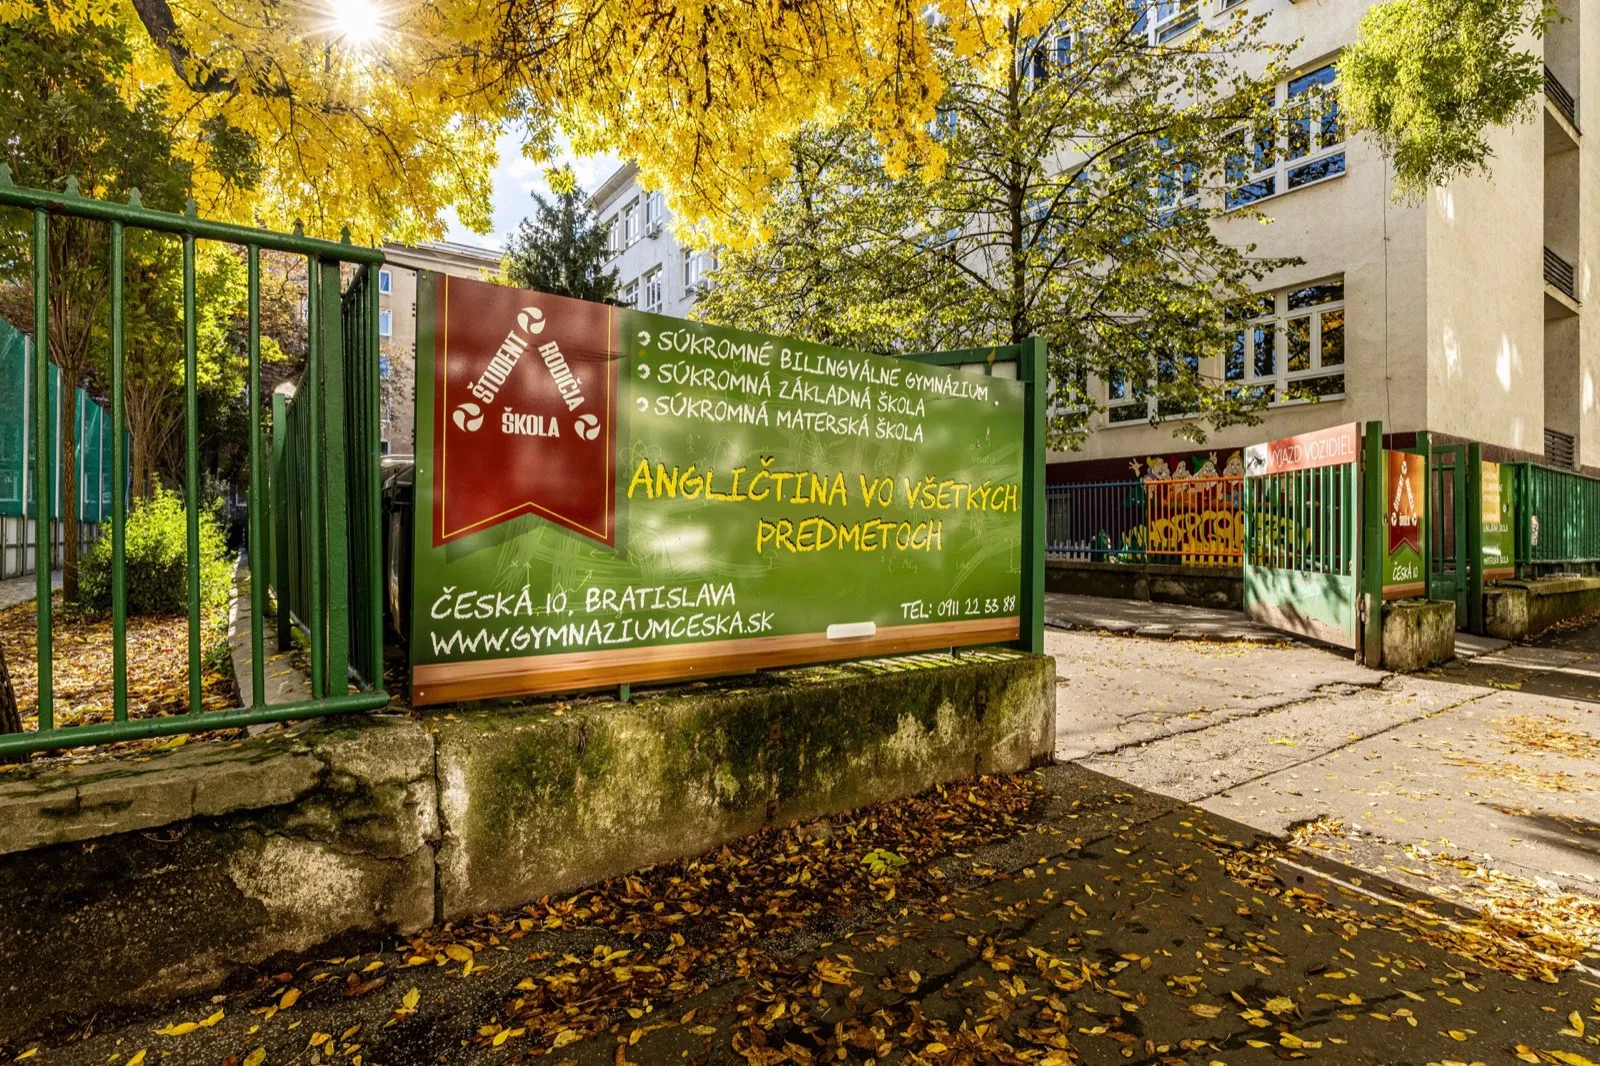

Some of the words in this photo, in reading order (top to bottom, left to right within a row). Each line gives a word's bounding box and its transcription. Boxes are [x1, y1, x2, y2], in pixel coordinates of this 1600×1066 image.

[467, 330, 529, 405] ŠTUDENT
[538, 340, 585, 412] RODIČIA
[657, 328, 773, 366] SÚKROMNÉ
[780, 348, 901, 387] BILINGVÁLNE
[905, 374, 988, 401] GYMNÁZIUM
[657, 360, 771, 397] SÚKROMNÁ
[779, 376, 871, 410] ZÁKLADNÁ
[877, 390, 925, 417] ŠKOLA
[501, 406, 560, 438] ŠKOLA
[654, 391, 769, 427] SÚKROMNÁ
[776, 408, 869, 438] MATERSKÁ
[875, 417, 923, 443] ŠKOLA
[1302, 434, 1354, 461] VOZIDIEL
[627, 455, 847, 507] ANGLIČTINA
[860, 473, 895, 508] VO
[904, 475, 1018, 513] VŠETKÝCH
[757, 516, 943, 553] PREDMETOCH
[1392, 561, 1412, 581] ČESKÁ
[430, 584, 533, 619] ČESKÁ
[585, 582, 736, 613] BRATISLAVA
[937, 599, 959, 616] 0911
[964, 597, 980, 614] 22
[984, 598, 999, 613] 33
[1003, 595, 1016, 612] 88
[430, 611, 775, 656] WWW.GYMNAZIUMCESKA.SK
